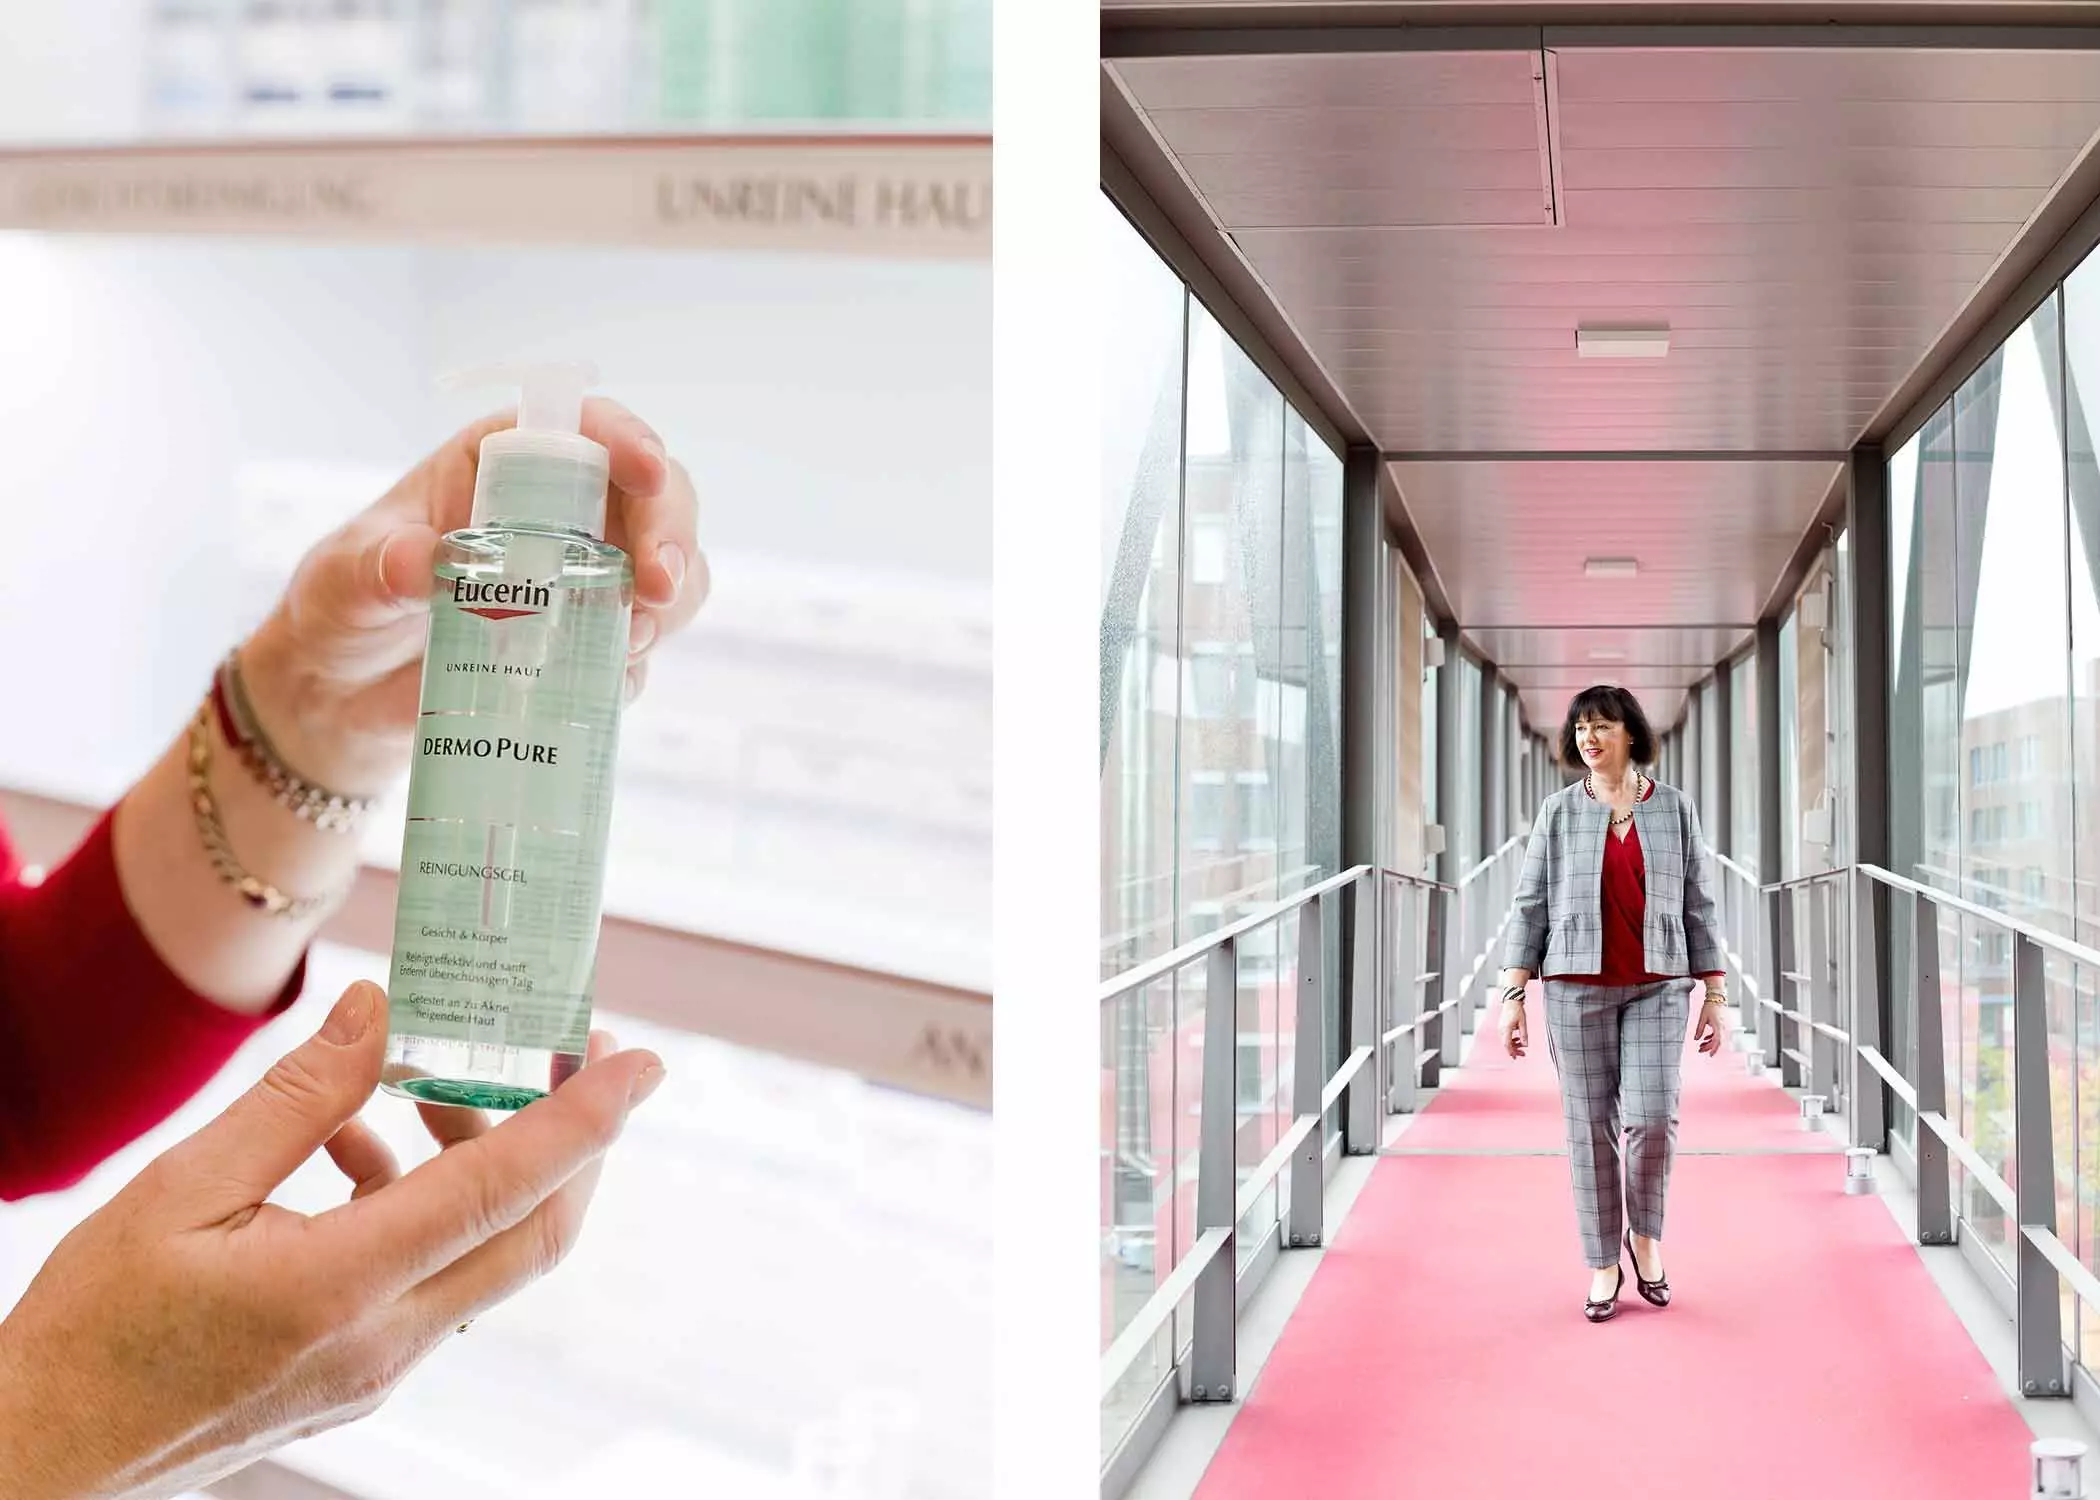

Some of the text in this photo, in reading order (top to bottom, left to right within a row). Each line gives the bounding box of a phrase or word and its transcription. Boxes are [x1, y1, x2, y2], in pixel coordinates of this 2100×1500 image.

[453, 576, 550, 607] Eucerin
[446, 663, 543, 678] UNREINE HAUT
[419, 861, 527, 884] REINIGUNGSGEL
[421, 926, 456, 940] Gesicht
[459, 929, 468, 940] &
[406, 951, 434, 966] Reinigt
[476, 958, 497, 970] und
[512, 975, 534, 992] Talg
[409, 993, 510, 1014] Getestet an zu Akne
[416, 1010, 495, 1027] neigender Haut
